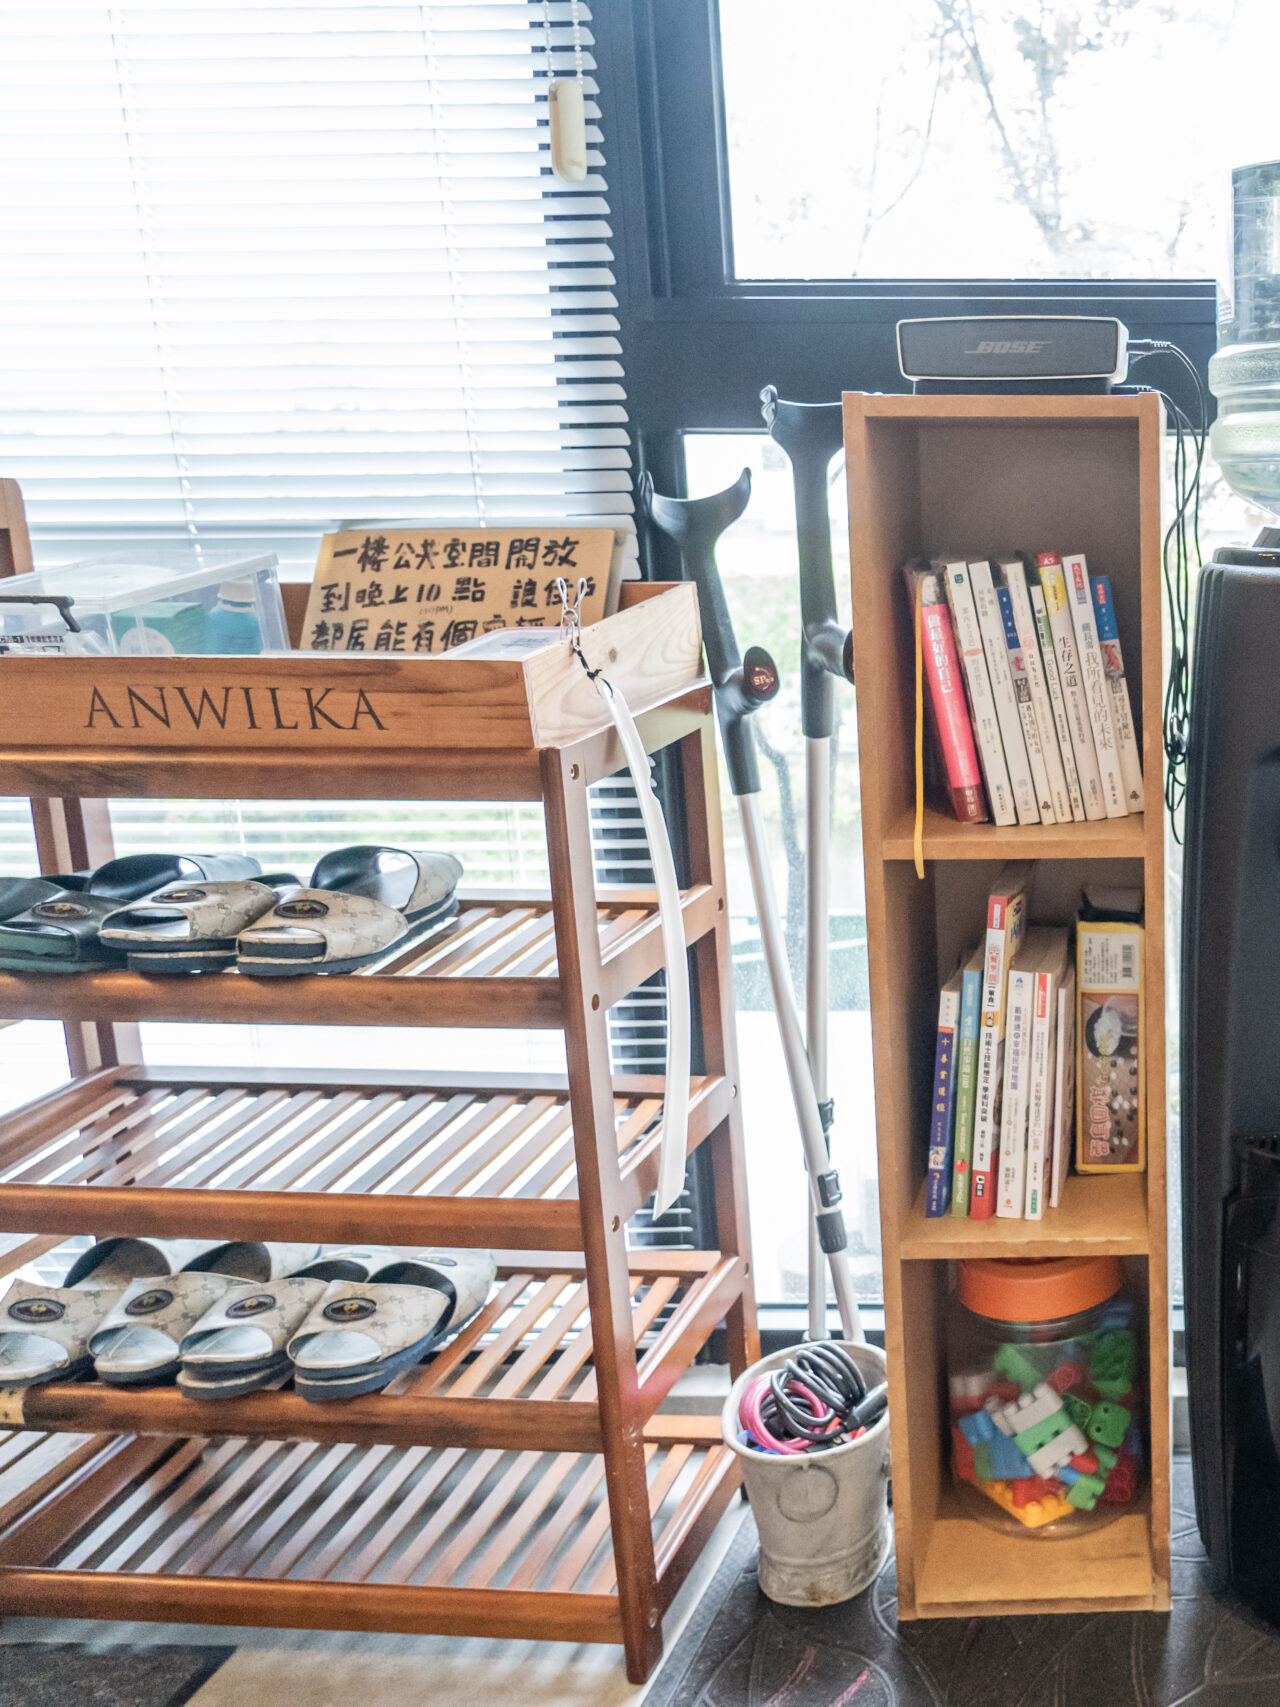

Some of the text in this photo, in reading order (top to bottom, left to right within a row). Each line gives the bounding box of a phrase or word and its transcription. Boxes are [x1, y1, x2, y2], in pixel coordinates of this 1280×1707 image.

[965, 341, 1052, 354] BOSE
[1059, 636, 1079, 688] 生存之道
[83, 685, 390, 731] ANWILKA
